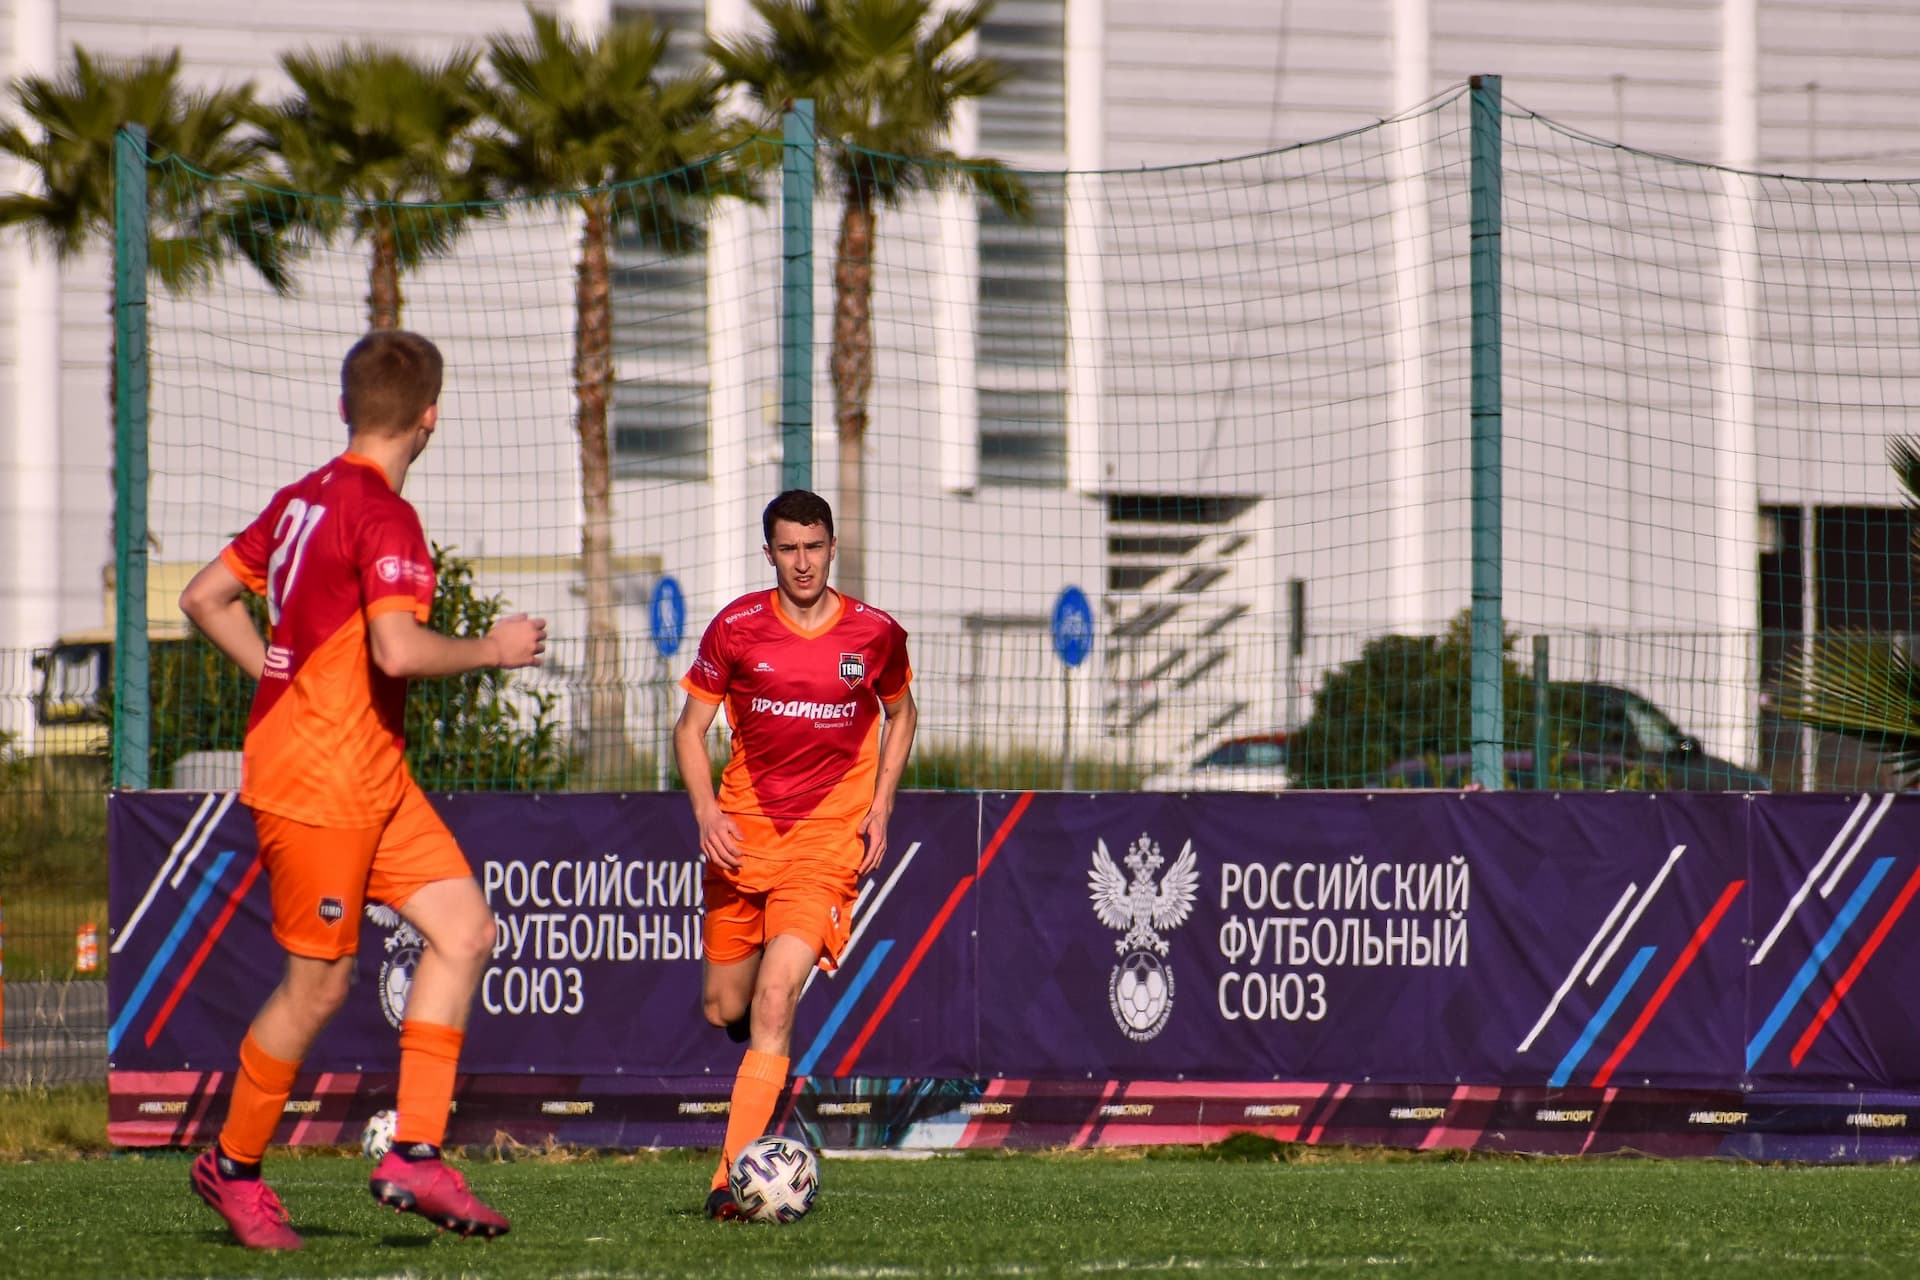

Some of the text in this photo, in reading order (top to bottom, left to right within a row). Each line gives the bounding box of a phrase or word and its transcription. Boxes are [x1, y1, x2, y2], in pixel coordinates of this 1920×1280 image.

[751, 697, 857, 720] ПРОДИНВЕСТ
[1220, 855, 1470, 911] РОССИЙСКИЙ
[1219, 911, 1469, 967] ФУТБОЛЬНЫЙ
[482, 966, 584, 1014] СОЮЗ
[1218, 972, 1327, 1021] СОЮЗ
